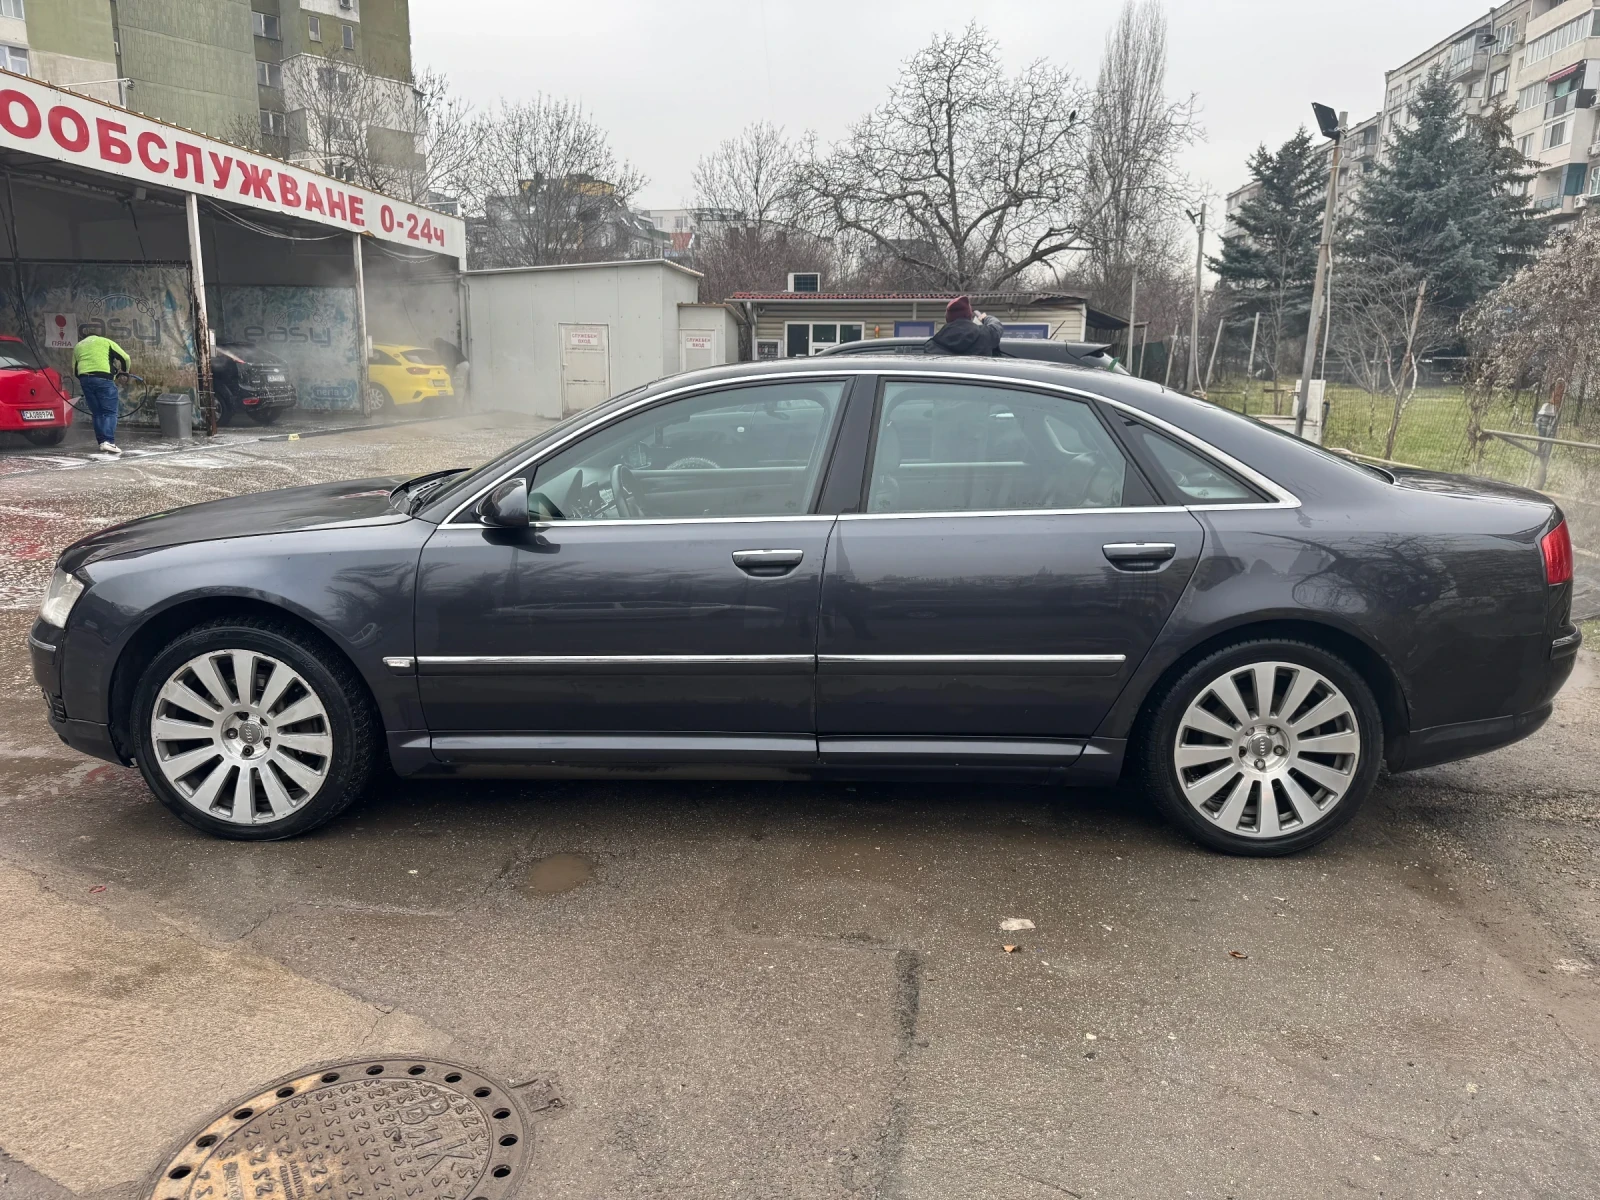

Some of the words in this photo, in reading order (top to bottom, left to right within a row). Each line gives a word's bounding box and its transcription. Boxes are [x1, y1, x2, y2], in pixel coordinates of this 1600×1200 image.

[0, 88, 366, 227] ООБСЛУЖВАНЕ
[380, 204, 446, 248] 0-24ч
[78, 317, 161, 346] asy
[243, 325, 332, 348] easy
